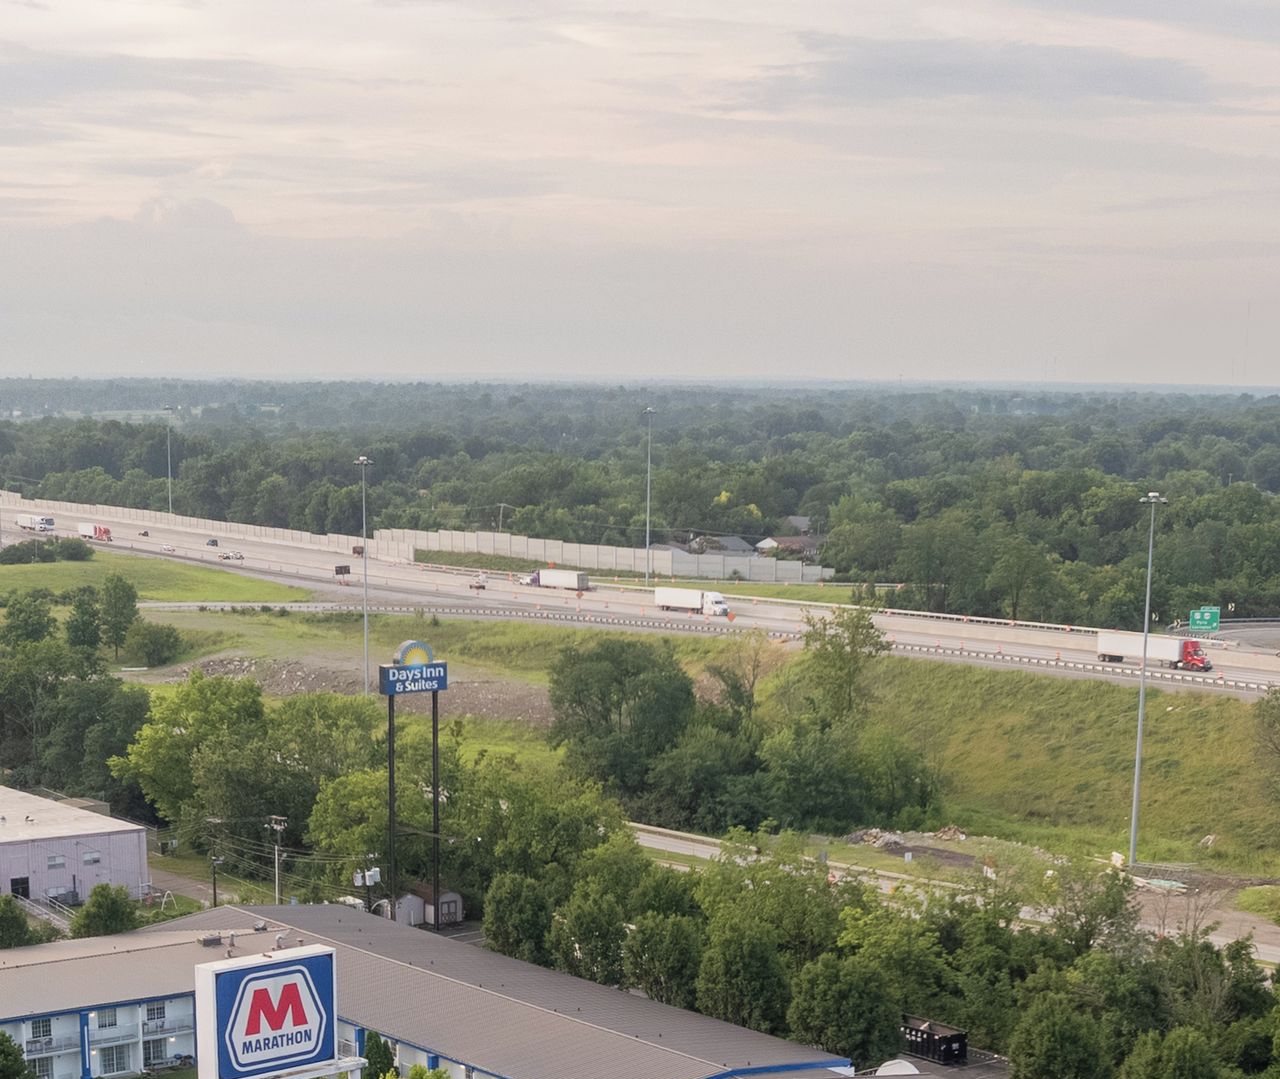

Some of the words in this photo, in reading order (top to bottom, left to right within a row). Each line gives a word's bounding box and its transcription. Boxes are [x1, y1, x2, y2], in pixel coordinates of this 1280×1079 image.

[389, 668, 422, 681] Days
[422, 666, 444, 678] Inn
[395, 682, 404, 692] &
[404, 679, 438, 691] Suites
[245, 983, 308, 1036] M
[242, 1029, 312, 1055] MARATHON
